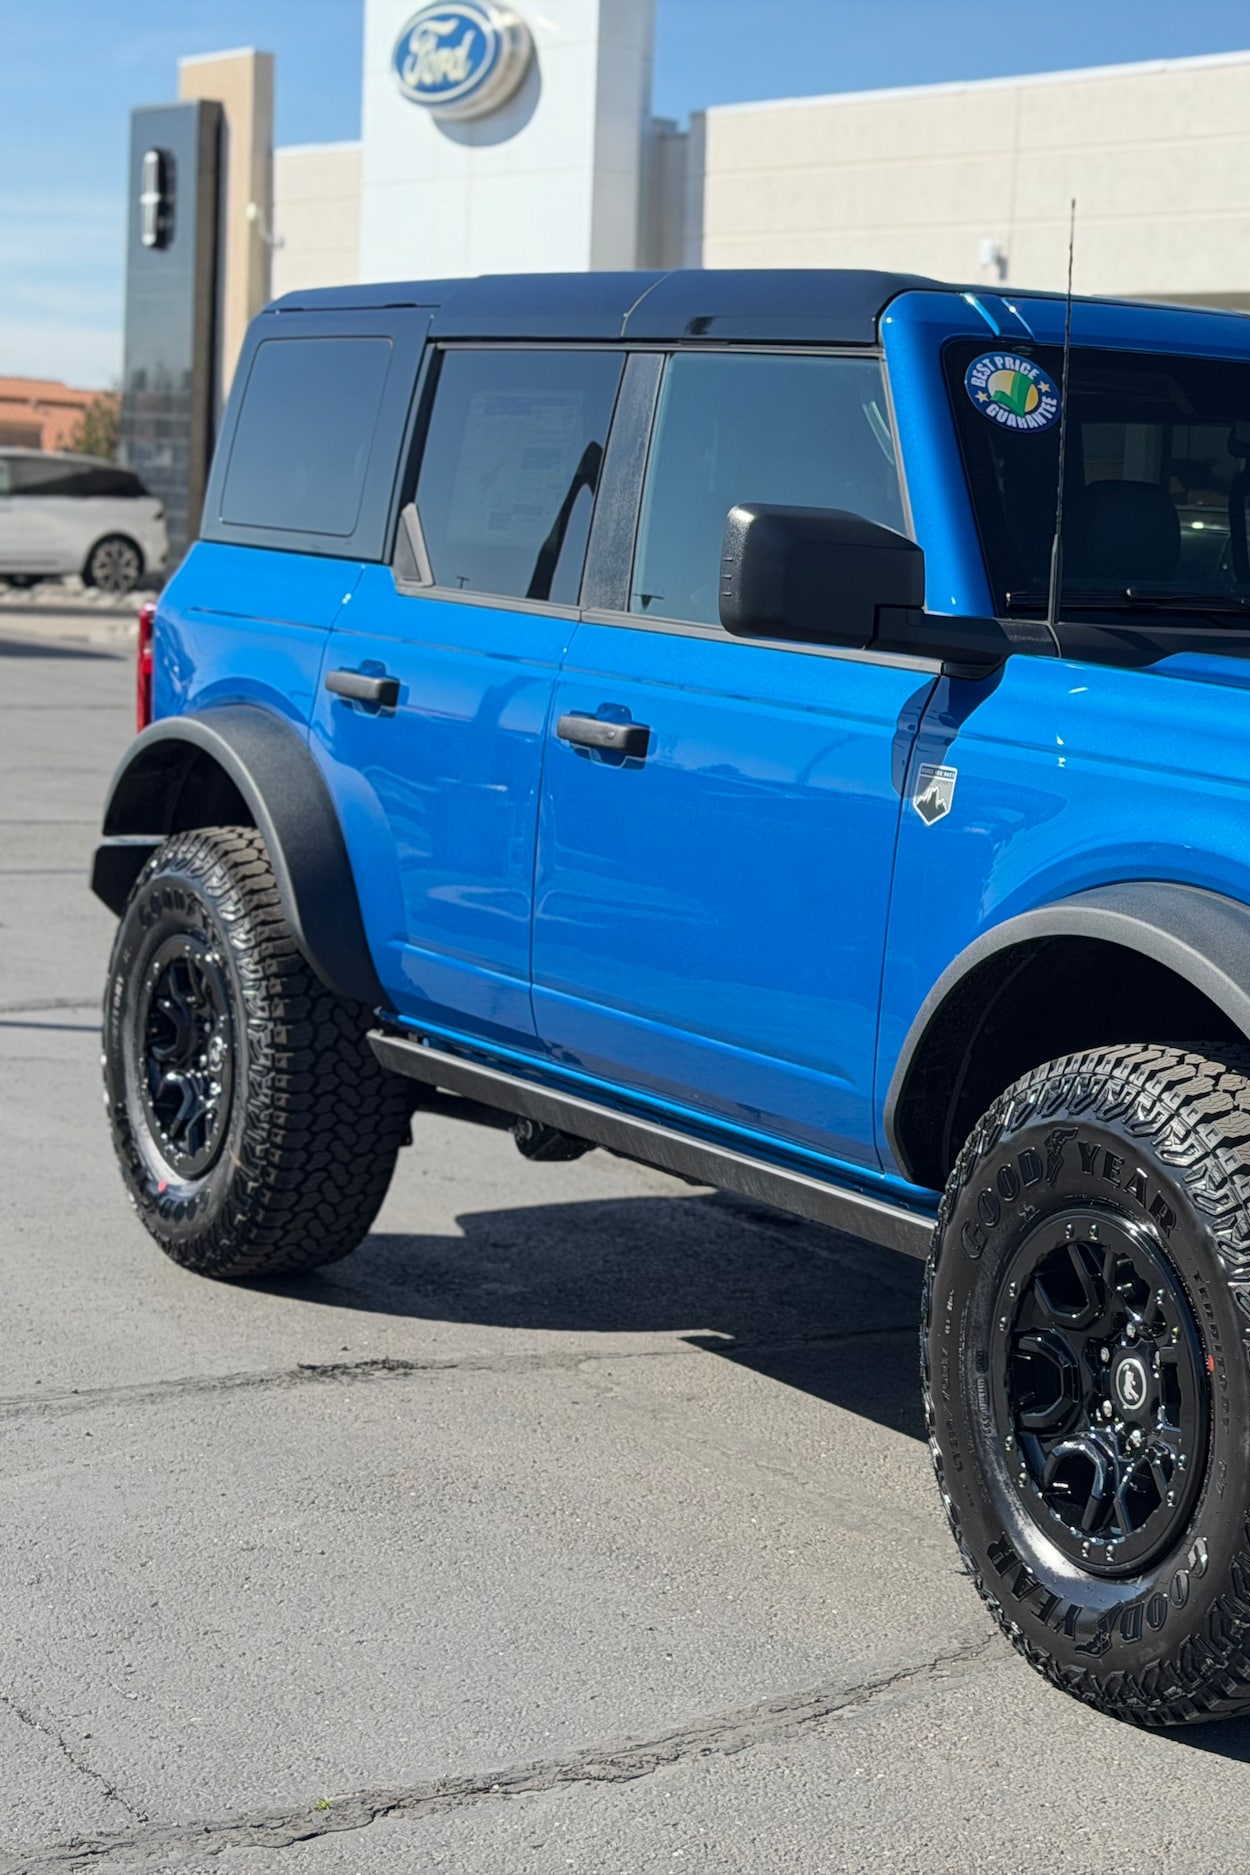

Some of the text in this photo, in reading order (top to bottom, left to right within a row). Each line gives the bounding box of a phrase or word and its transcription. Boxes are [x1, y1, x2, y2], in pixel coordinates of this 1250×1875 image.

[401, 17, 476, 88] Ford
[970, 355, 1041, 388] BEST PRICE
[985, 395, 1058, 430] GUARANTEE
